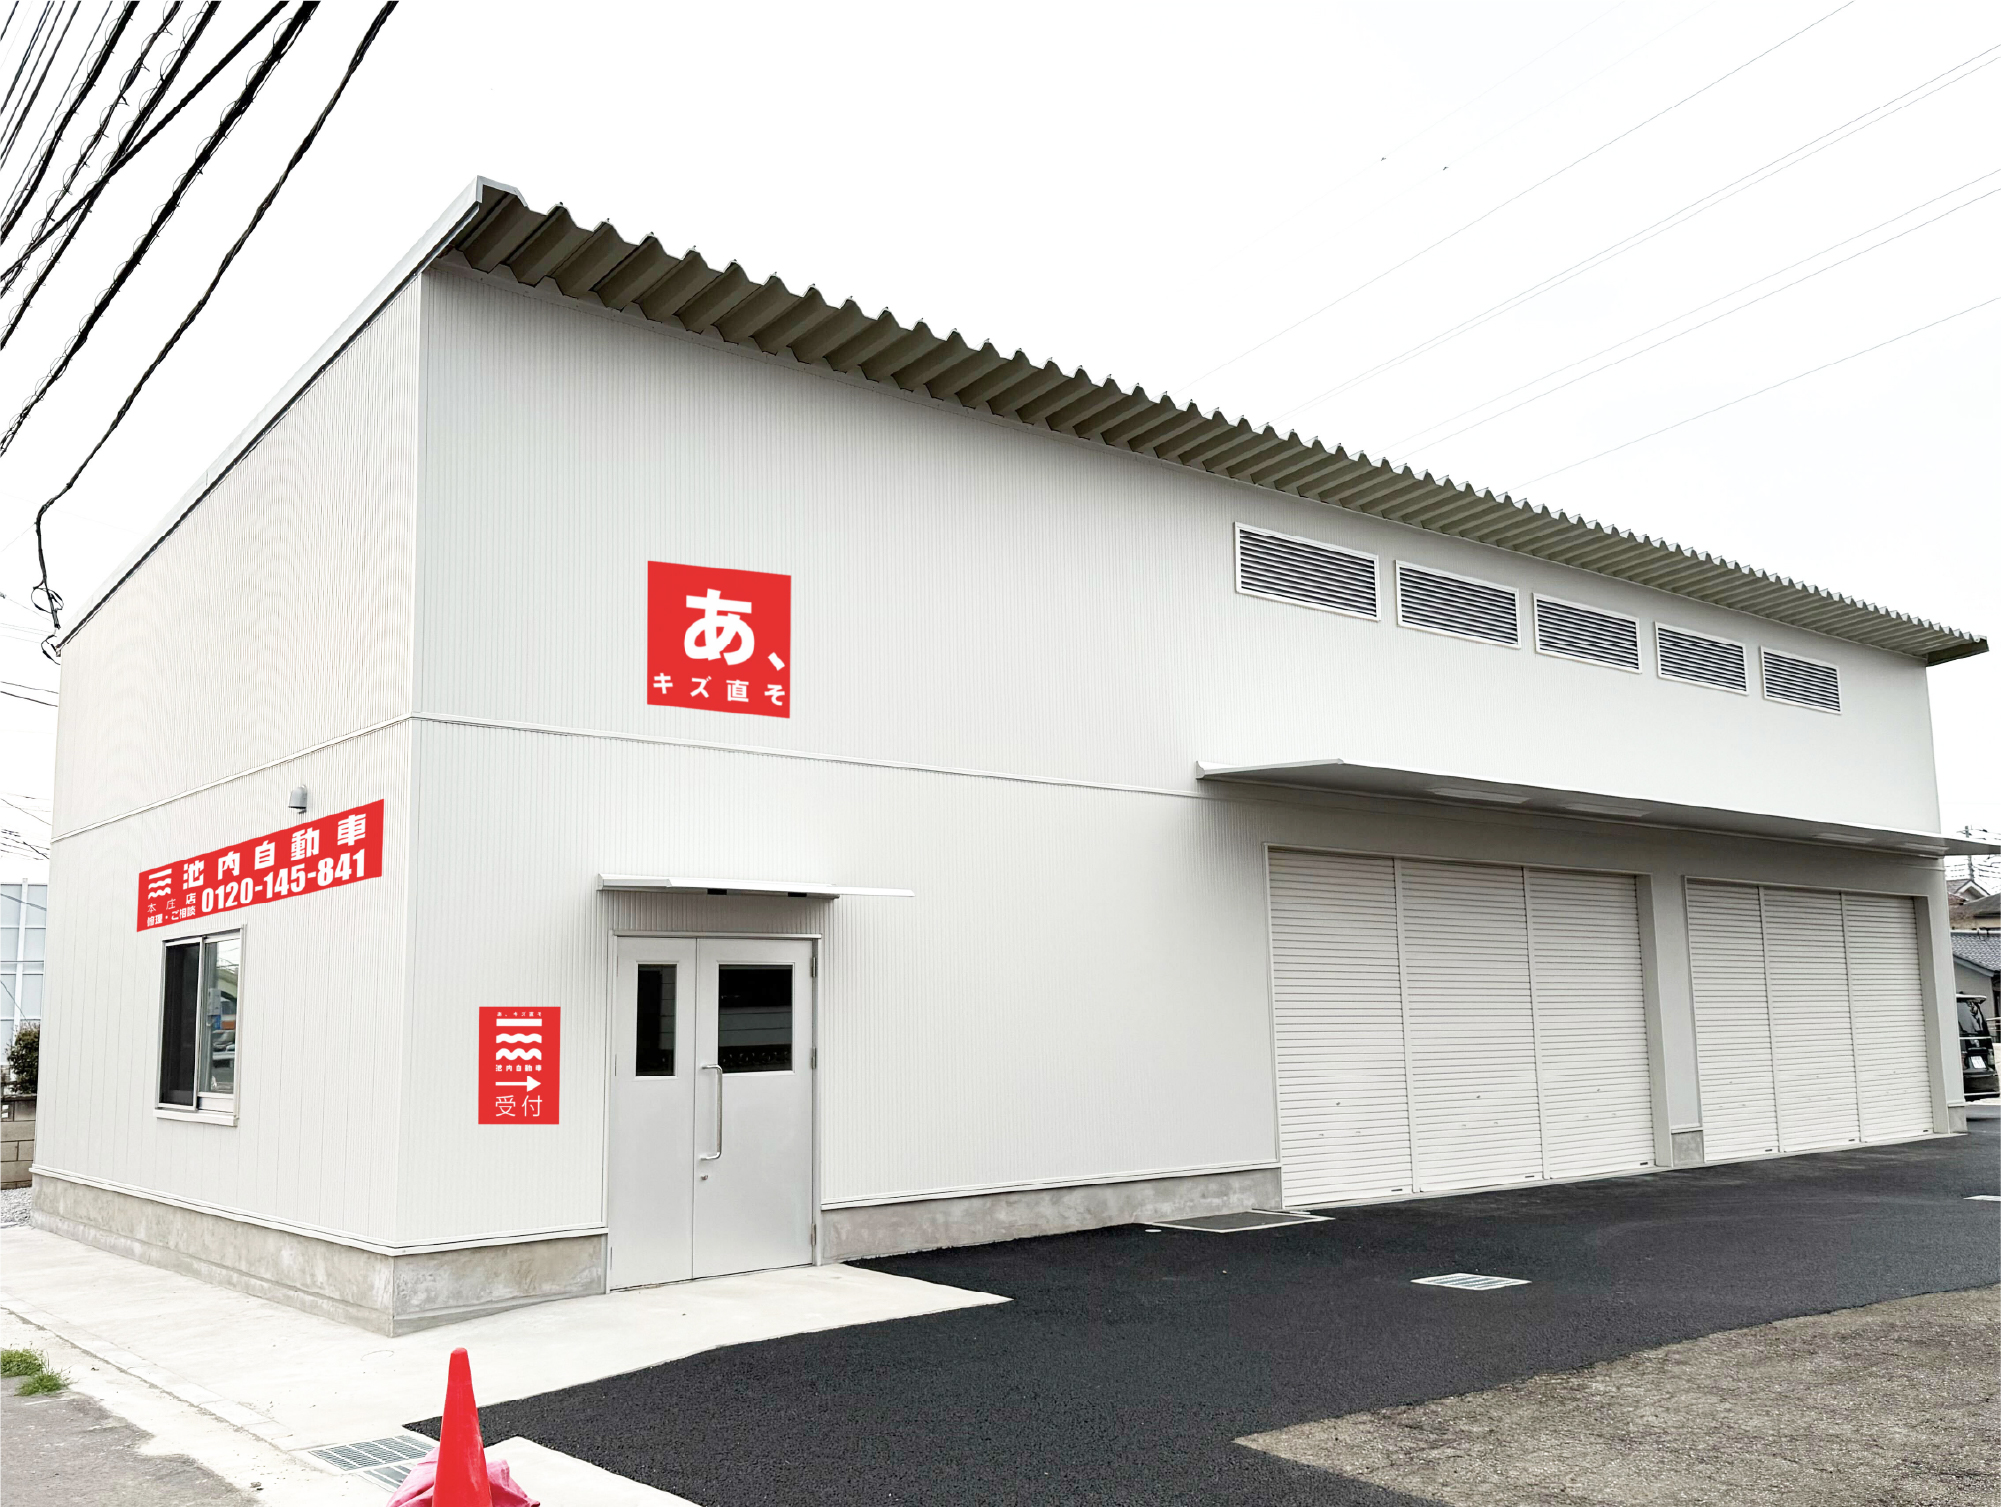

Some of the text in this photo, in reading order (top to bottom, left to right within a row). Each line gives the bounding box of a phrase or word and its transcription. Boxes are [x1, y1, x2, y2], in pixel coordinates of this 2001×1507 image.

[684, 588, 786, 671] あ、
[653, 672, 786, 706] キズ直そ
[182, 813, 367, 890] 池内自動車
[201, 848, 366, 913] 0120-145-841
[495, 1094, 543, 1117] 受付
